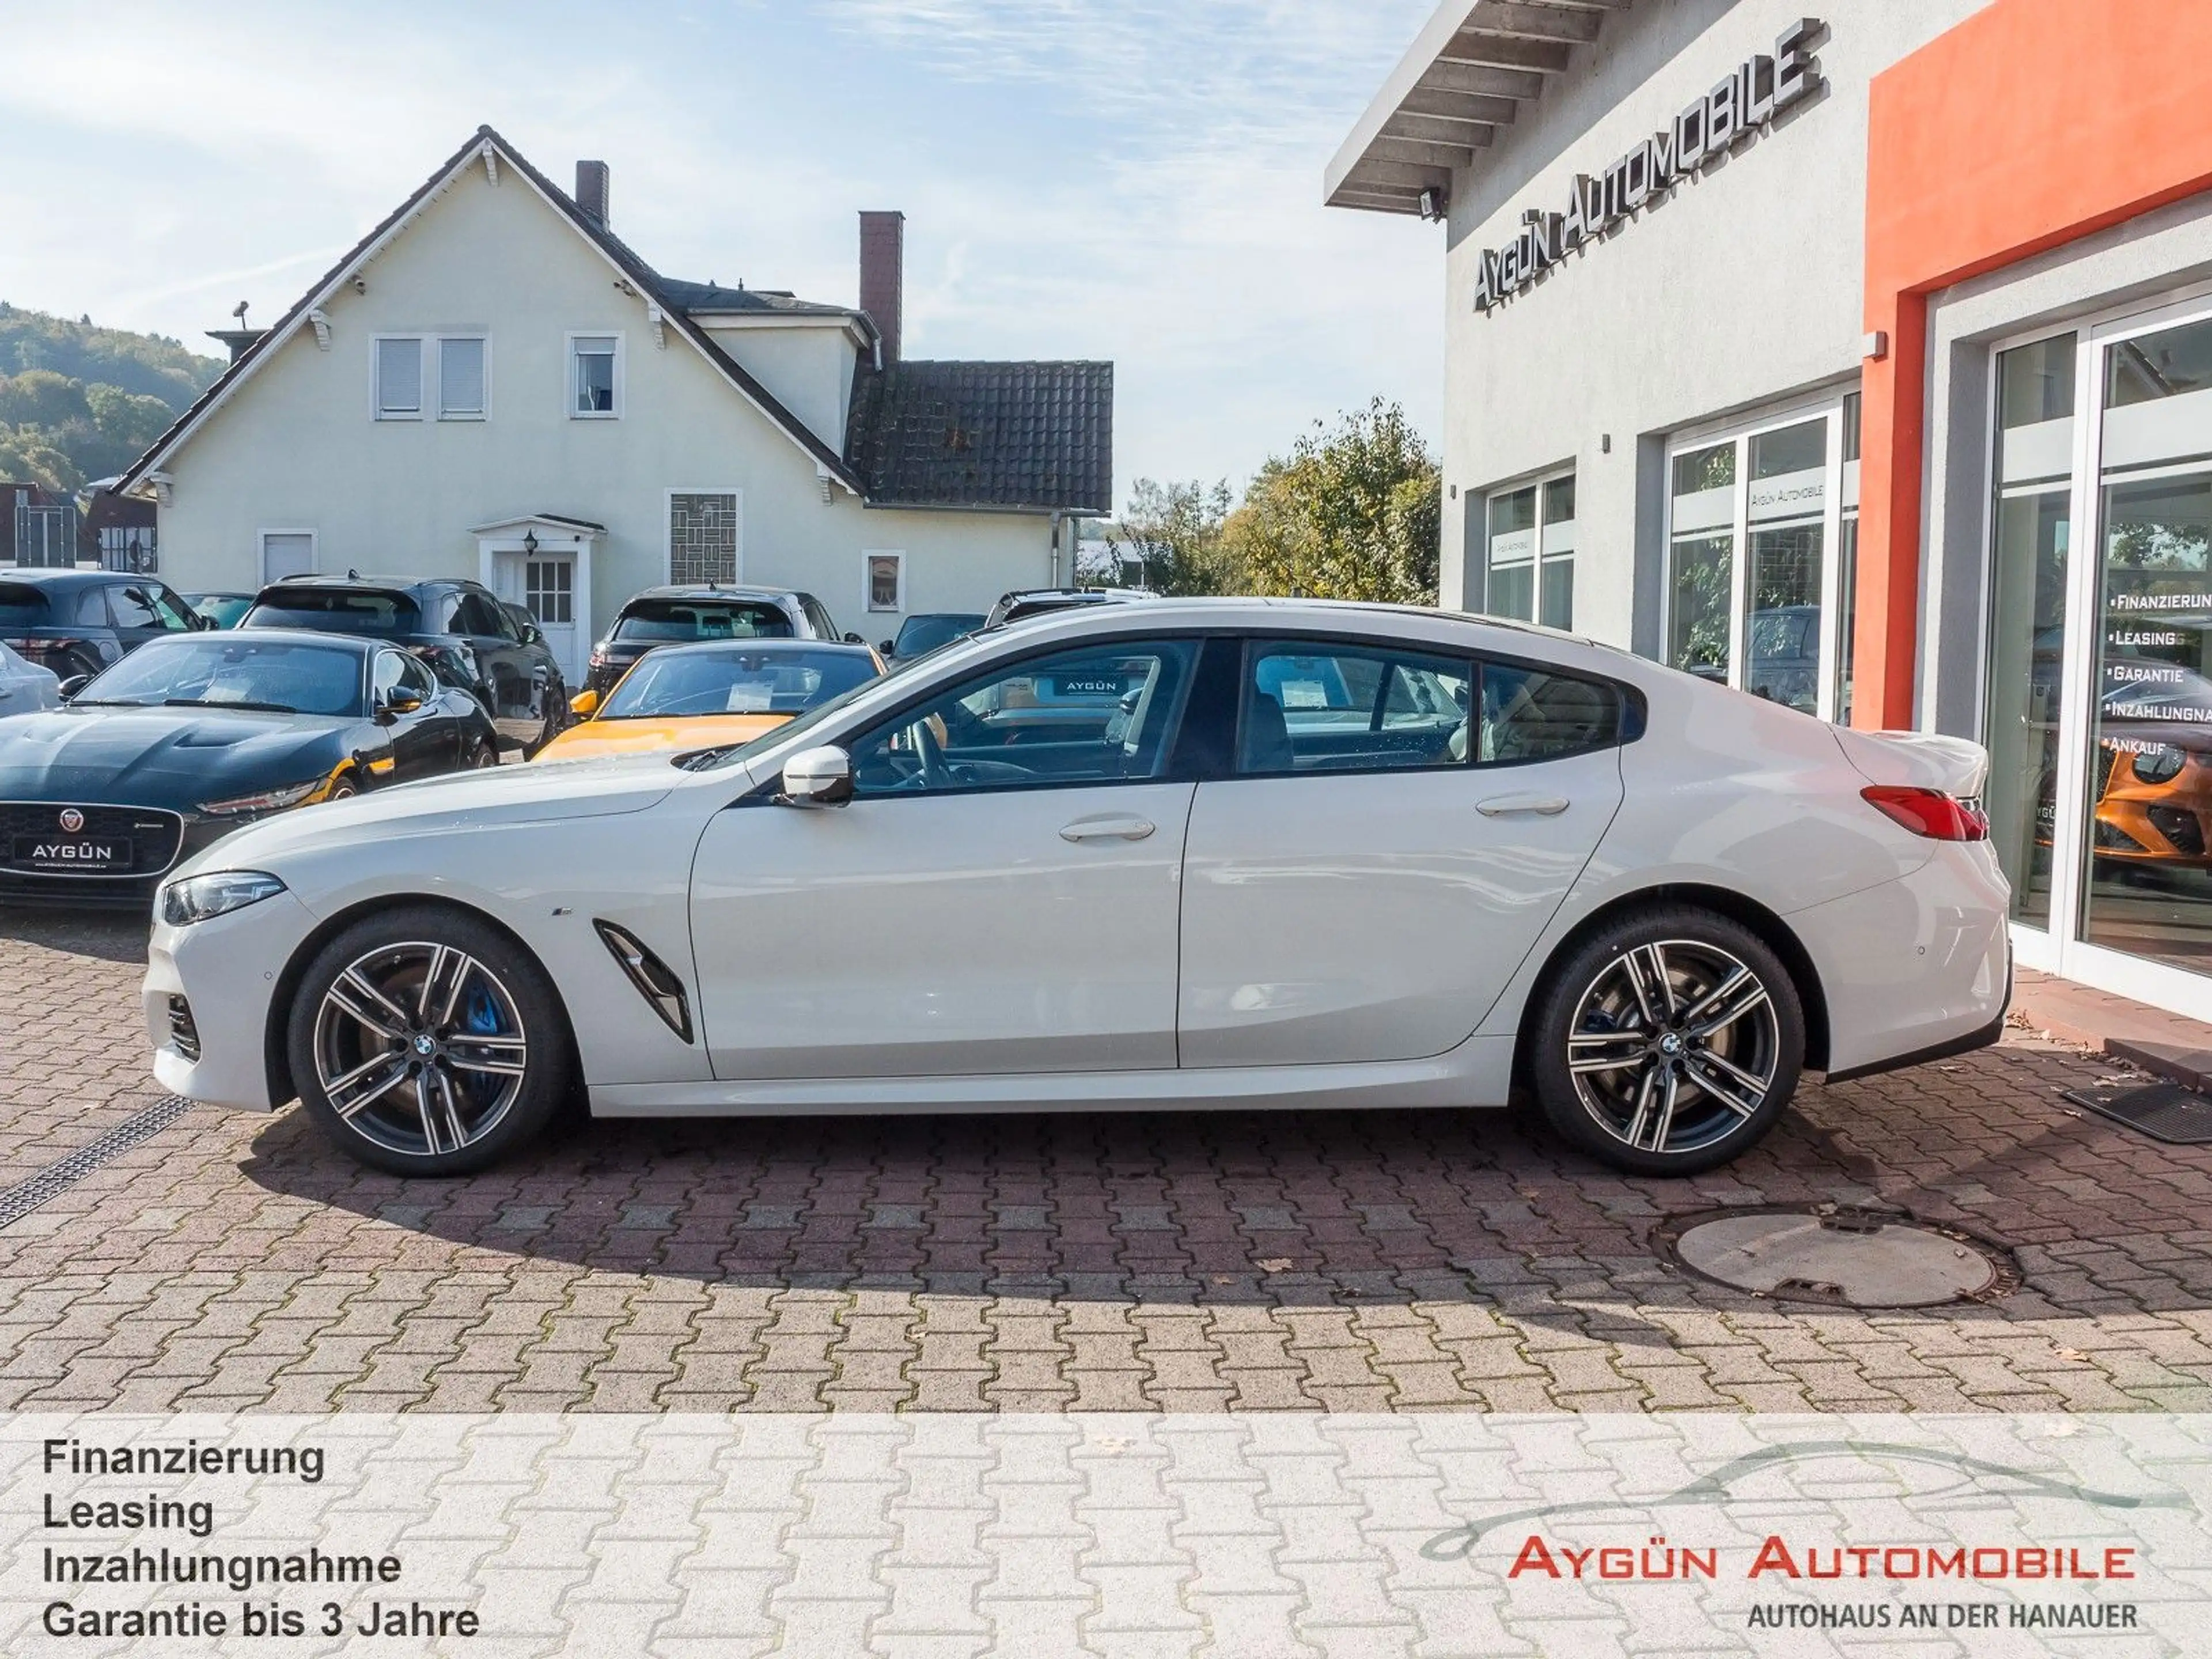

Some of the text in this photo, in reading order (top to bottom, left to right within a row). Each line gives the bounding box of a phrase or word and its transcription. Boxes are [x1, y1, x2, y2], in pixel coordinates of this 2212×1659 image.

[1474, 18, 1820, 313] AYGÜN AUTOMOBILE
[2115, 630, 2175, 645] LEASING
[2113, 666, 2184, 683] GARANTIE
[1067, 680, 1116, 691] AYGÜN
[2109, 737, 2166, 756] ANKAUF
[32, 842, 111, 859] AYGÜN
